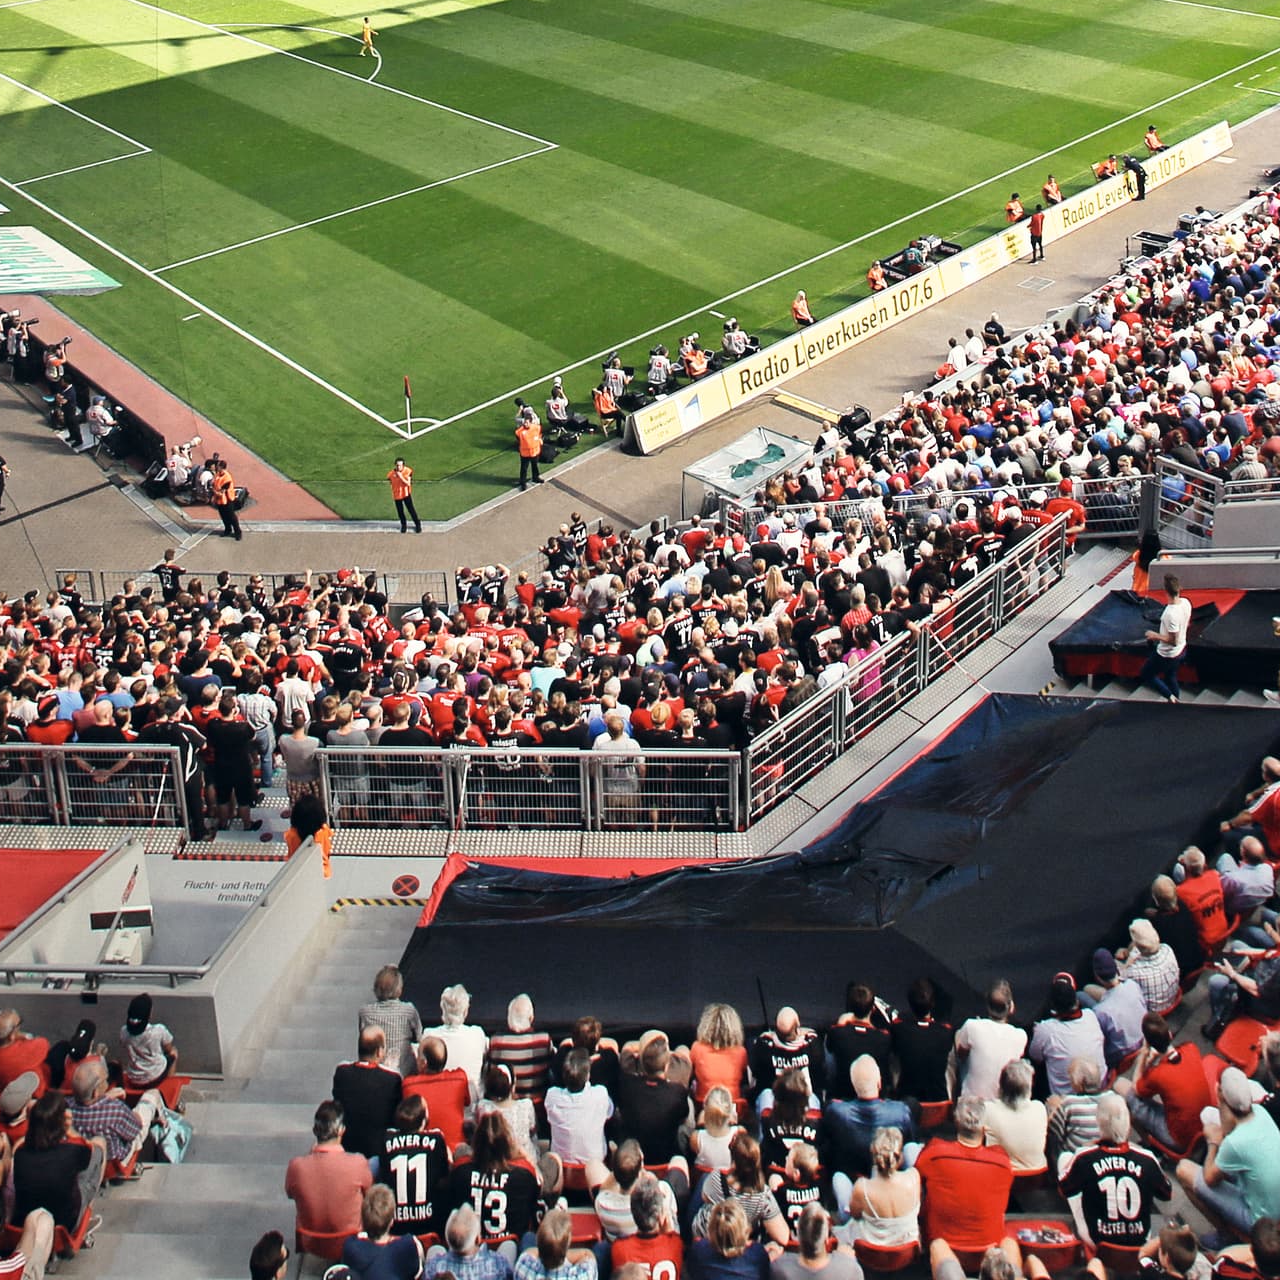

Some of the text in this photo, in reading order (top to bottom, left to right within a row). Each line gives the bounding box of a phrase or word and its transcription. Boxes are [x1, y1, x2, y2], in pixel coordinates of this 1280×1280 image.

[1062, 148, 1187, 230] Radio Leverkuen 107.6
[738, 277, 935, 396] Radio Leverkusen 107.6
[183, 879, 270, 891] Flucht- und Rettu
[217, 892, 261, 903] freihalte
[385, 1133, 436, 1152] BAYER 04
[803, 1125, 817, 1141] 04
[1092, 1156, 1143, 1177] BAYER 04
[390, 1152, 429, 1206] 11
[470, 1170, 510, 1189] RALF
[1097, 1176, 1142, 1221] 10
